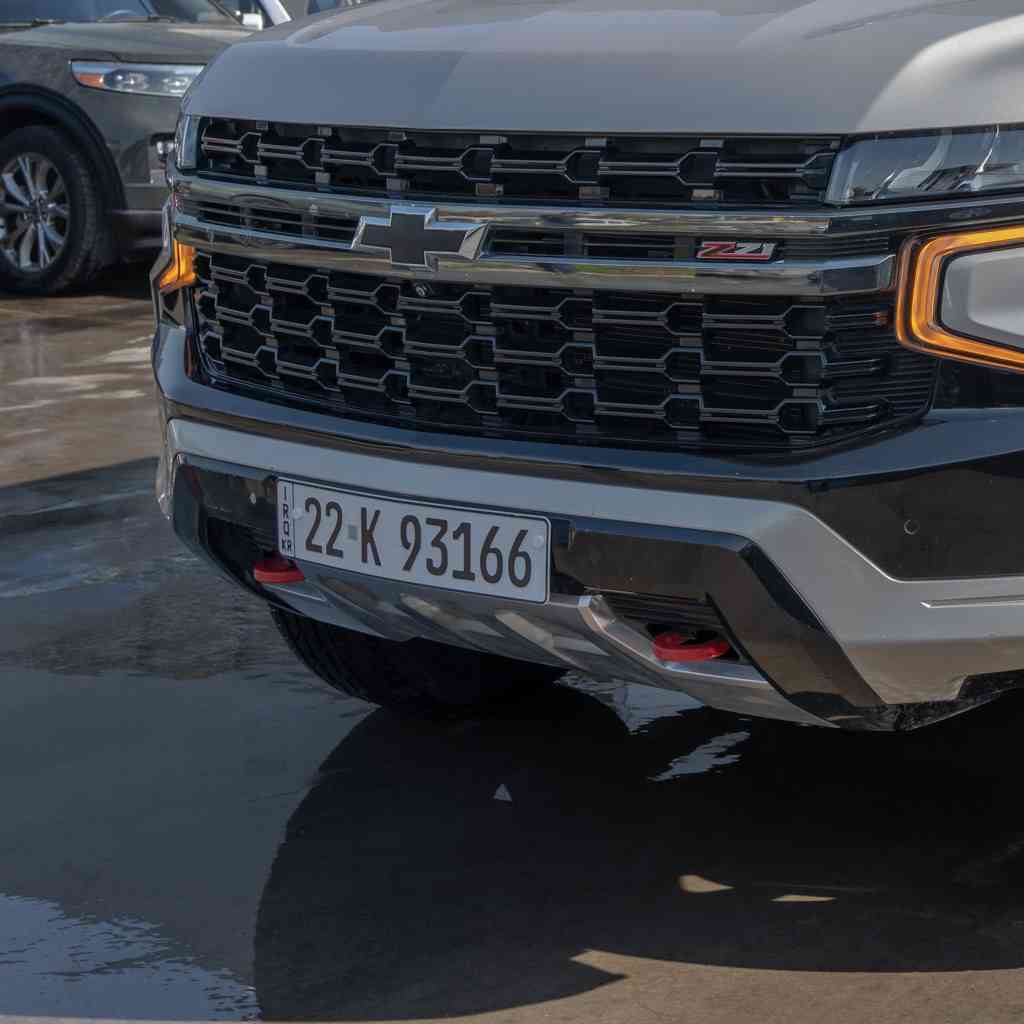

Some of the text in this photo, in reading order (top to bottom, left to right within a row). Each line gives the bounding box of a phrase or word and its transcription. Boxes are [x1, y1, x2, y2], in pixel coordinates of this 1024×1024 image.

[696, 241, 777, 261] Z71
[305, 497, 532, 588] 22 K 93166
